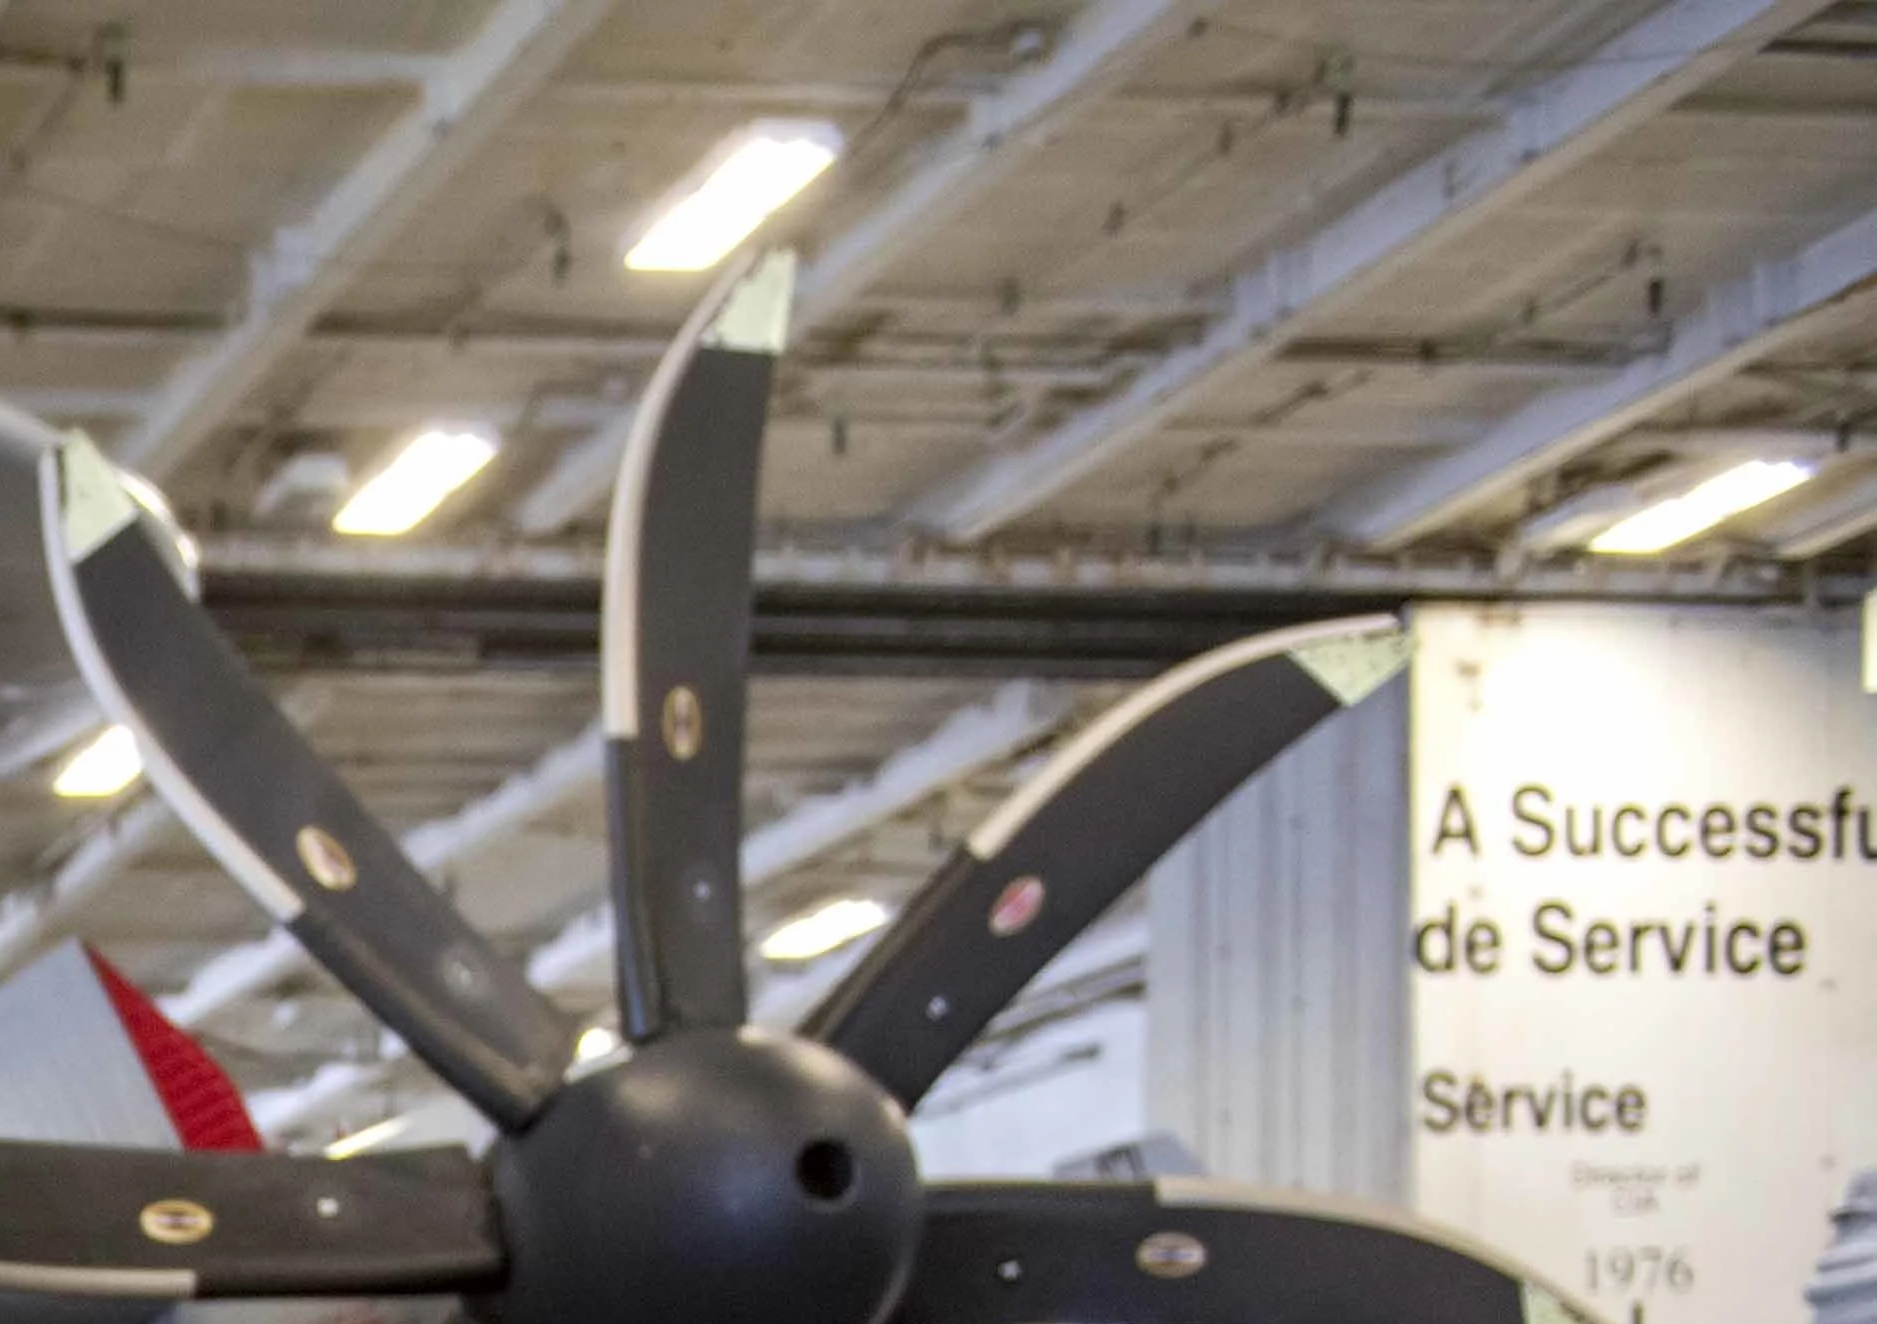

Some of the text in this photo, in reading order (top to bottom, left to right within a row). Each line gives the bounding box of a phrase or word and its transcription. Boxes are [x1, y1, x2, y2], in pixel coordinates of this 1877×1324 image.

[1432, 784, 1480, 857] A
[1531, 900, 1806, 976] Service
[1421, 1069, 1647, 1133] Service
[1584, 1245, 1695, 1297] 1976
